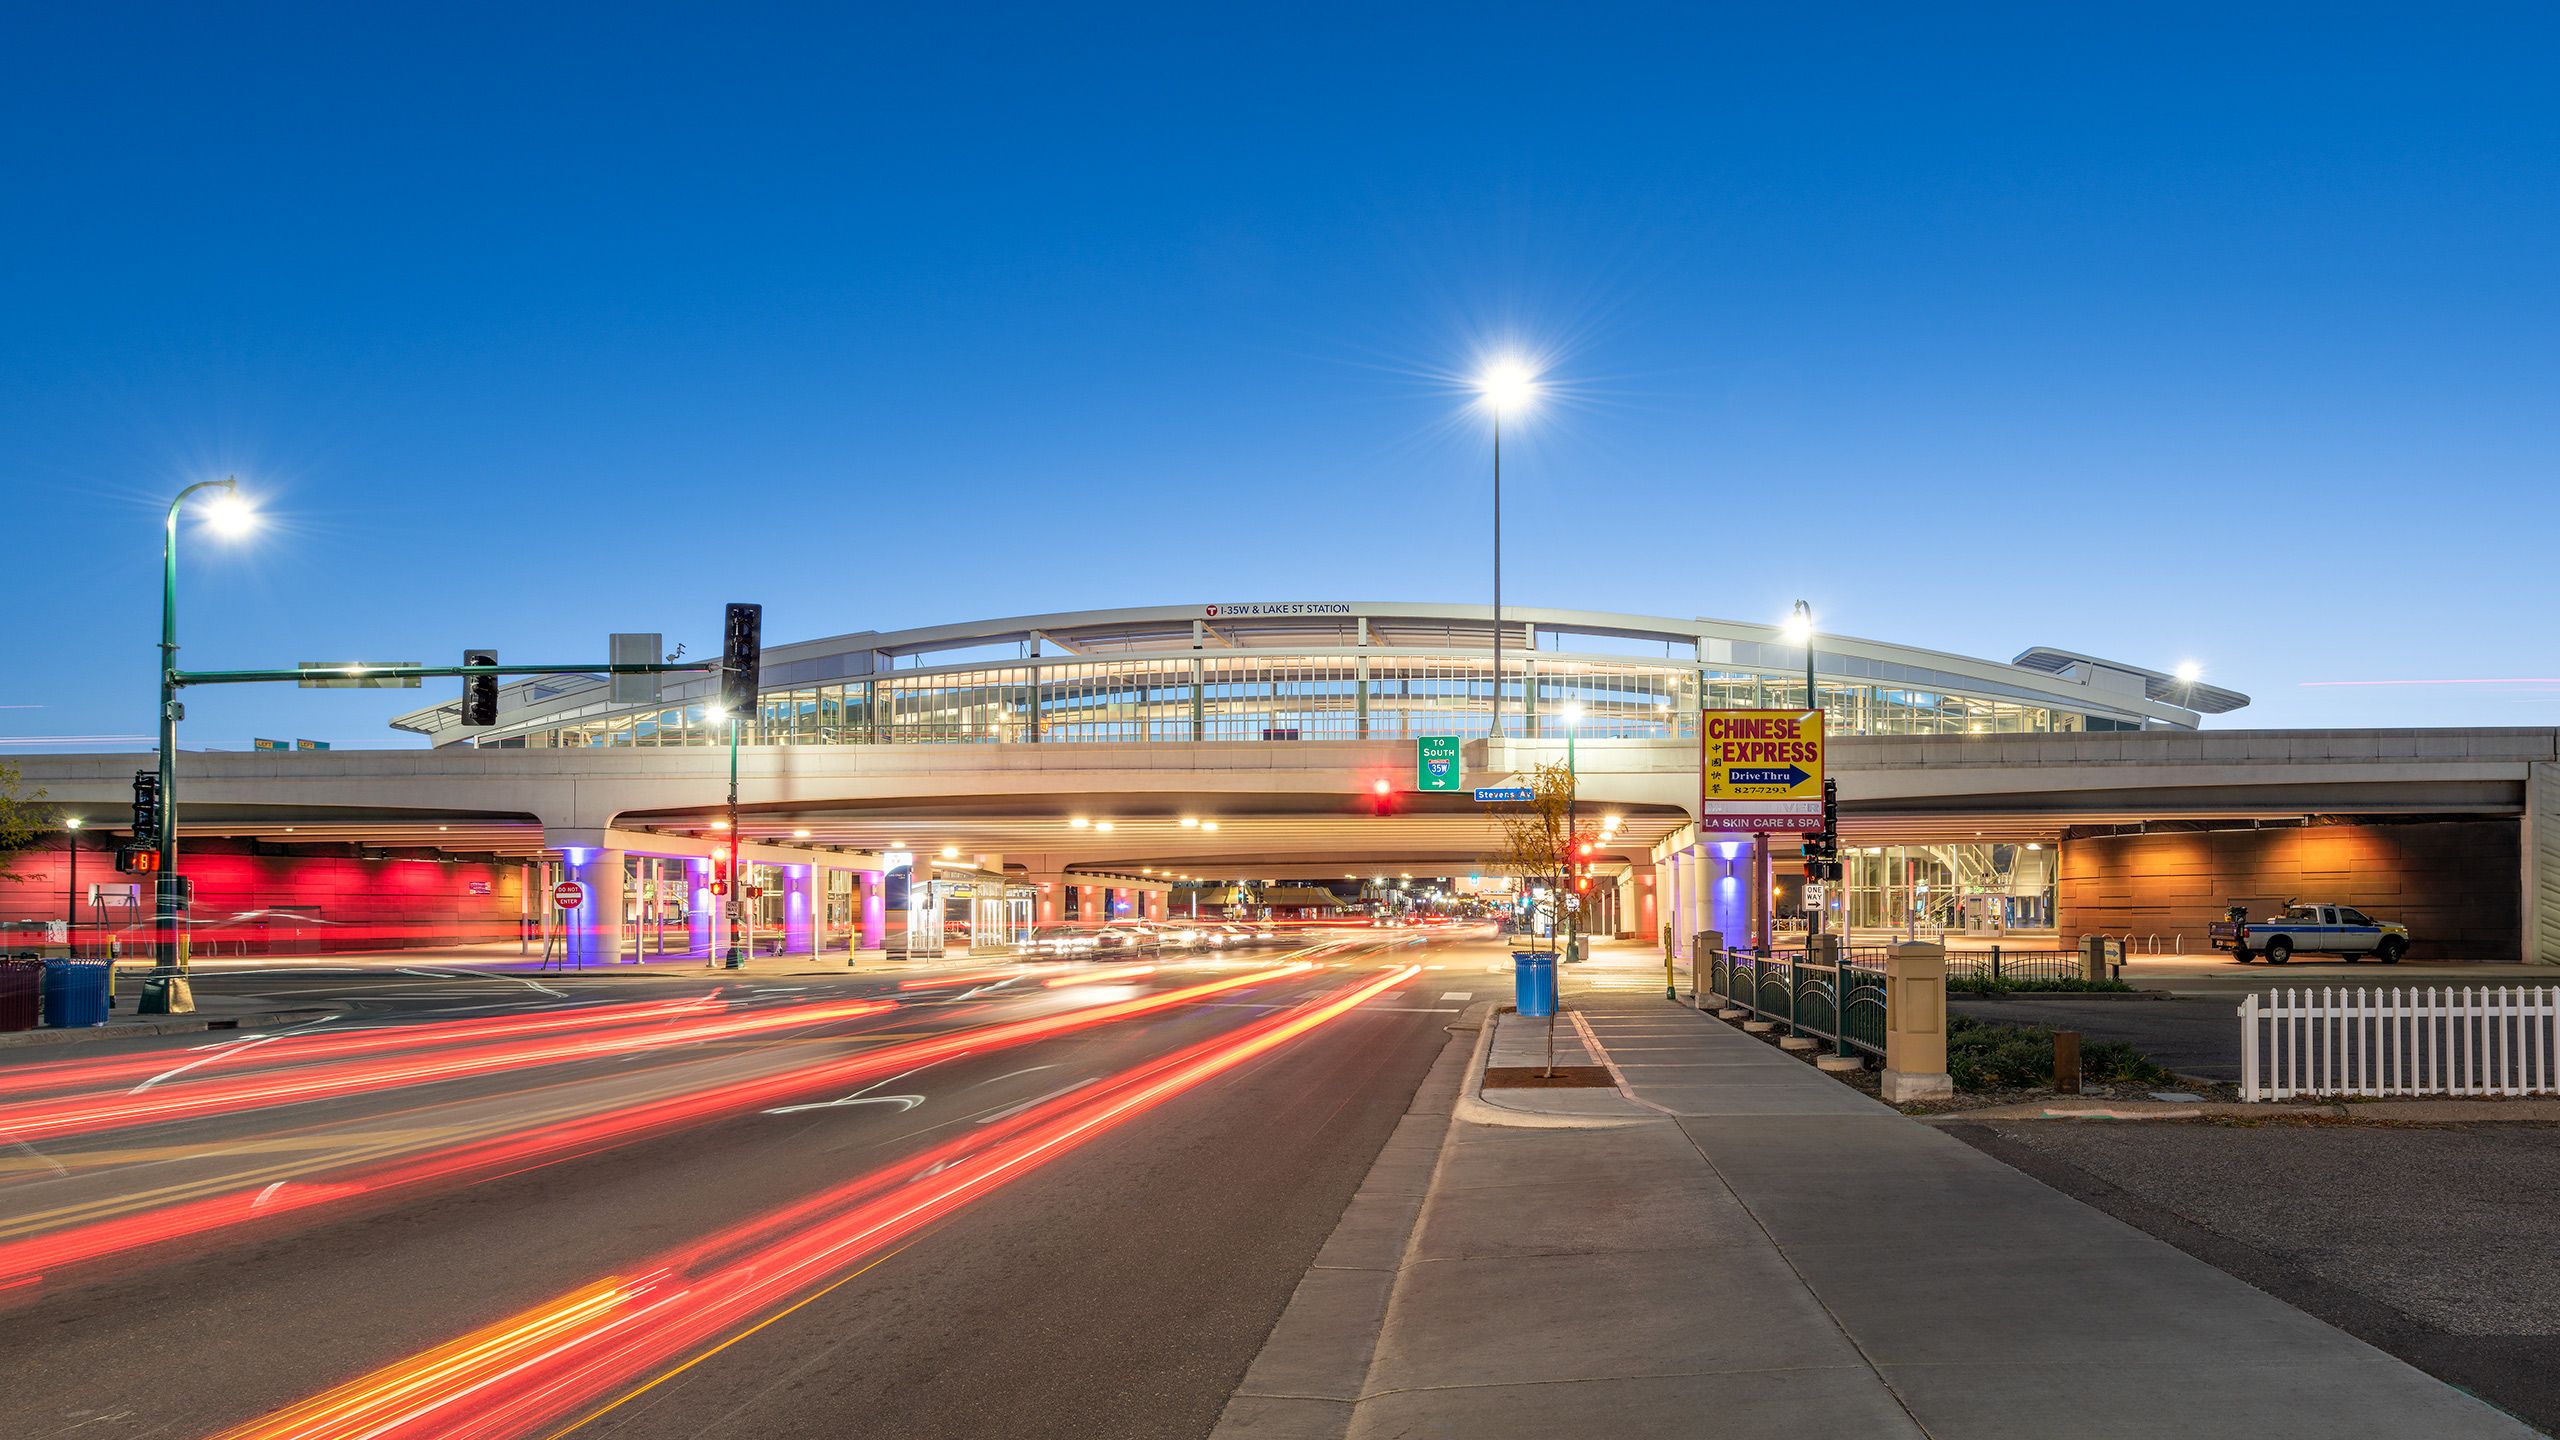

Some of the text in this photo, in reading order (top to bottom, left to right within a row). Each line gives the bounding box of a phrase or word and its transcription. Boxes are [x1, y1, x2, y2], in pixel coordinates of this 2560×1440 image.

[1221, 606, 1249, 614] I-35W
[1252, 605, 1260, 614] &
[1263, 605, 1288, 613] LAKE
[1292, 605, 1303, 613] ST
[1307, 604, 1350, 613] STATION
[1709, 719, 1800, 739] CHINESE
[1424, 748, 1454, 756] SOUTH
[1723, 742, 1818, 762] EXPRESS
[1432, 764, 1448, 772] 35W
[1731, 772, 1790, 780] Drive Thru
[1706, 819, 1820, 827] LA SKIN CARE & SPA
